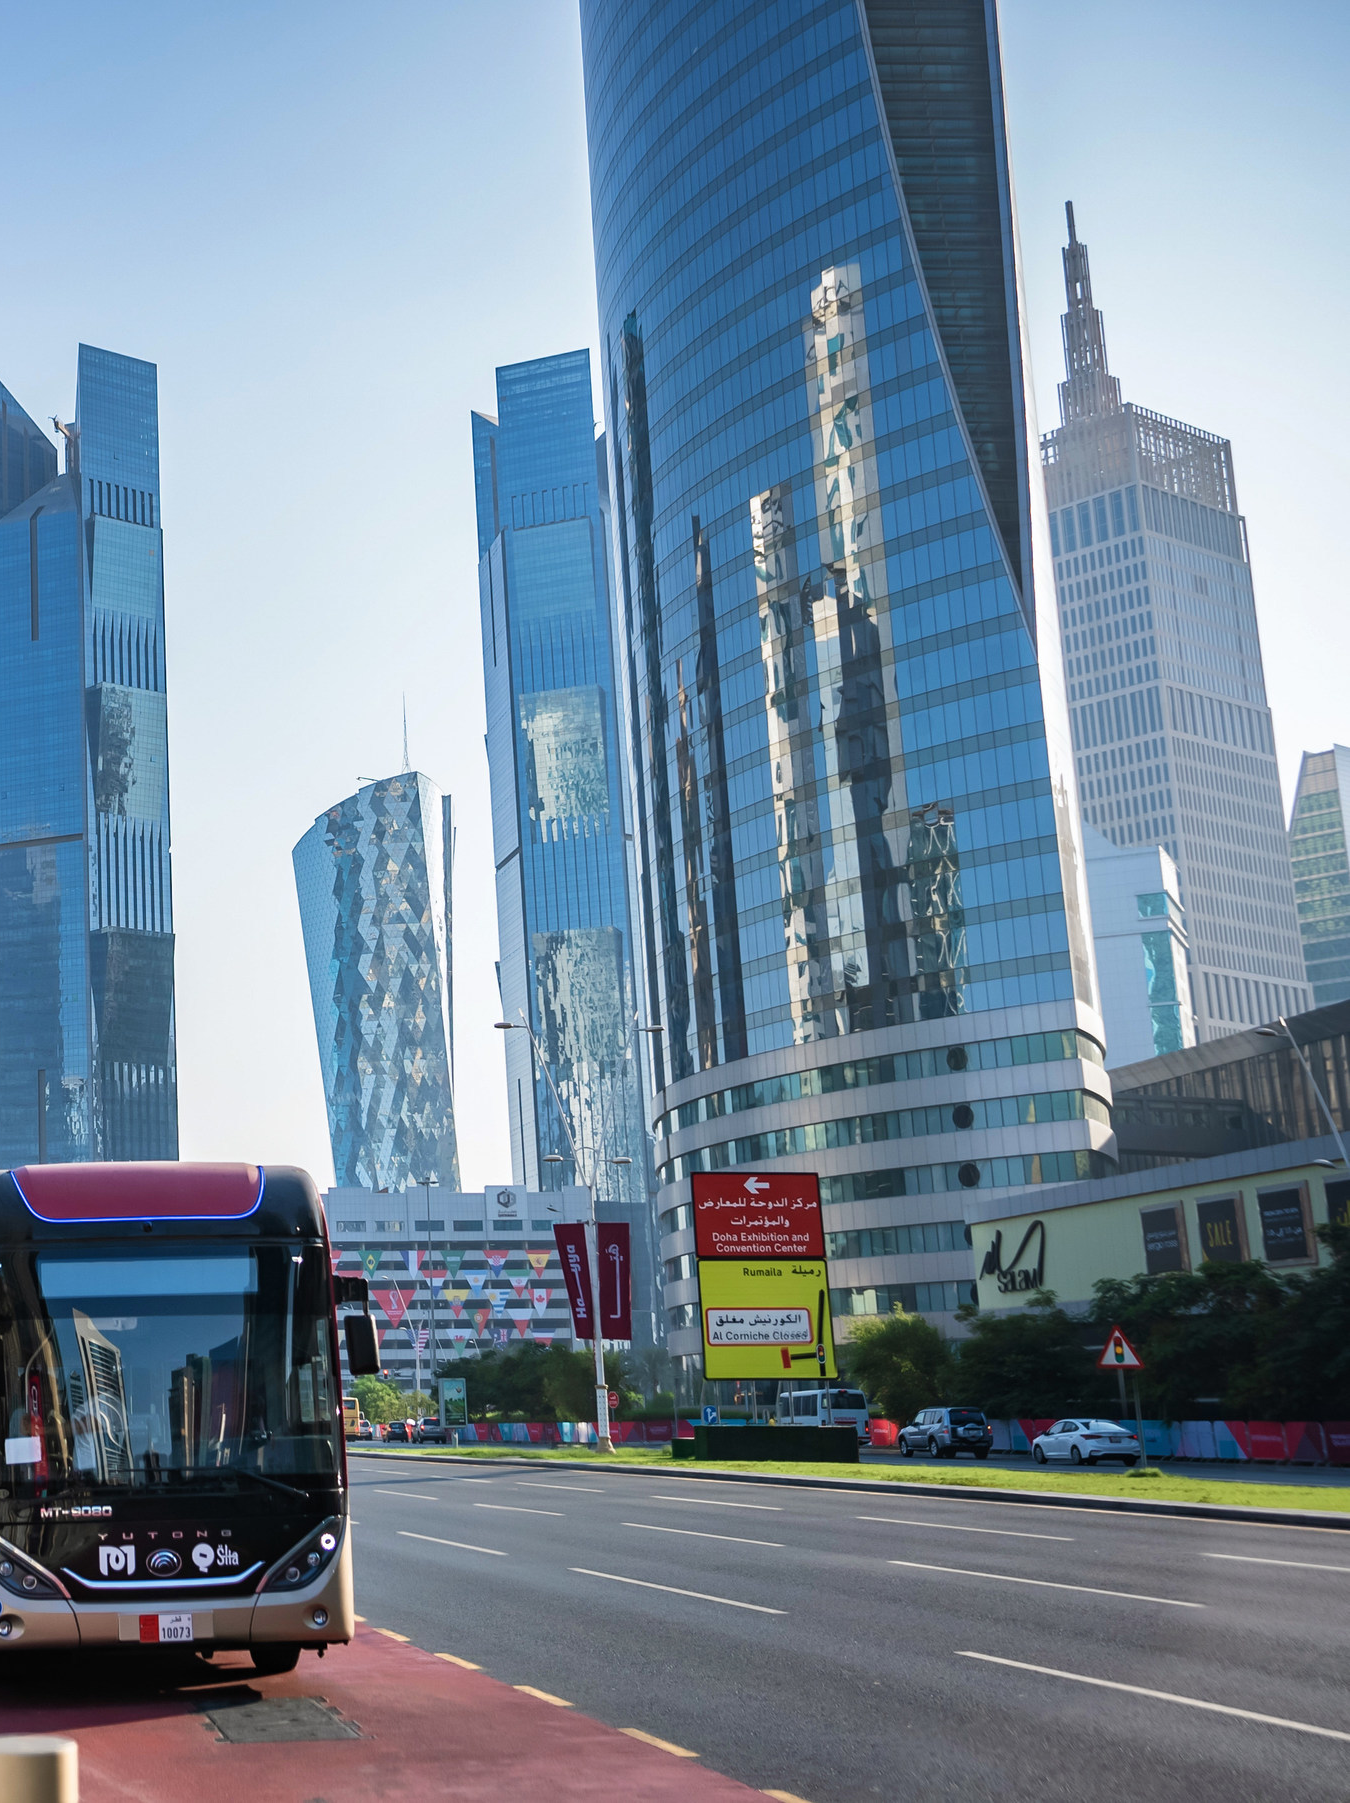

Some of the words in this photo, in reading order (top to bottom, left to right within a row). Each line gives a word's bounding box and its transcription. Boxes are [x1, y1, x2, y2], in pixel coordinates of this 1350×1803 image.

[698, 1197, 747, 1210] للمعارض
[750, 1197, 788, 1210] الدوحة
[791, 1198, 817, 1210] مركز
[730, 1215, 790, 1228] والمؤتمرات
[712, 1233, 738, 1242] Doha
[741, 1232, 789, 1242] Exhibition
[791, 1232, 810, 1242] and
[1206, 1220, 1233, 1248] SALE
[716, 1243, 772, 1253] Convention
[774, 1243, 807, 1253] Center
[743, 1267, 782, 1277] Rumaila
[791, 1265, 822, 1277] رميلة
[716, 1314, 745, 1327] مغلق
[749, 1314, 801, 1327] الكورنيش
[712, 1332, 723, 1341] Al
[725, 1331, 770, 1341] Corniche
[772, 1329, 808, 1341] Closed
[98, 1529, 232, 1541] YUTONG
[170, 1616, 182, 1624] قطر
[161, 1626, 191, 1639] 10073
